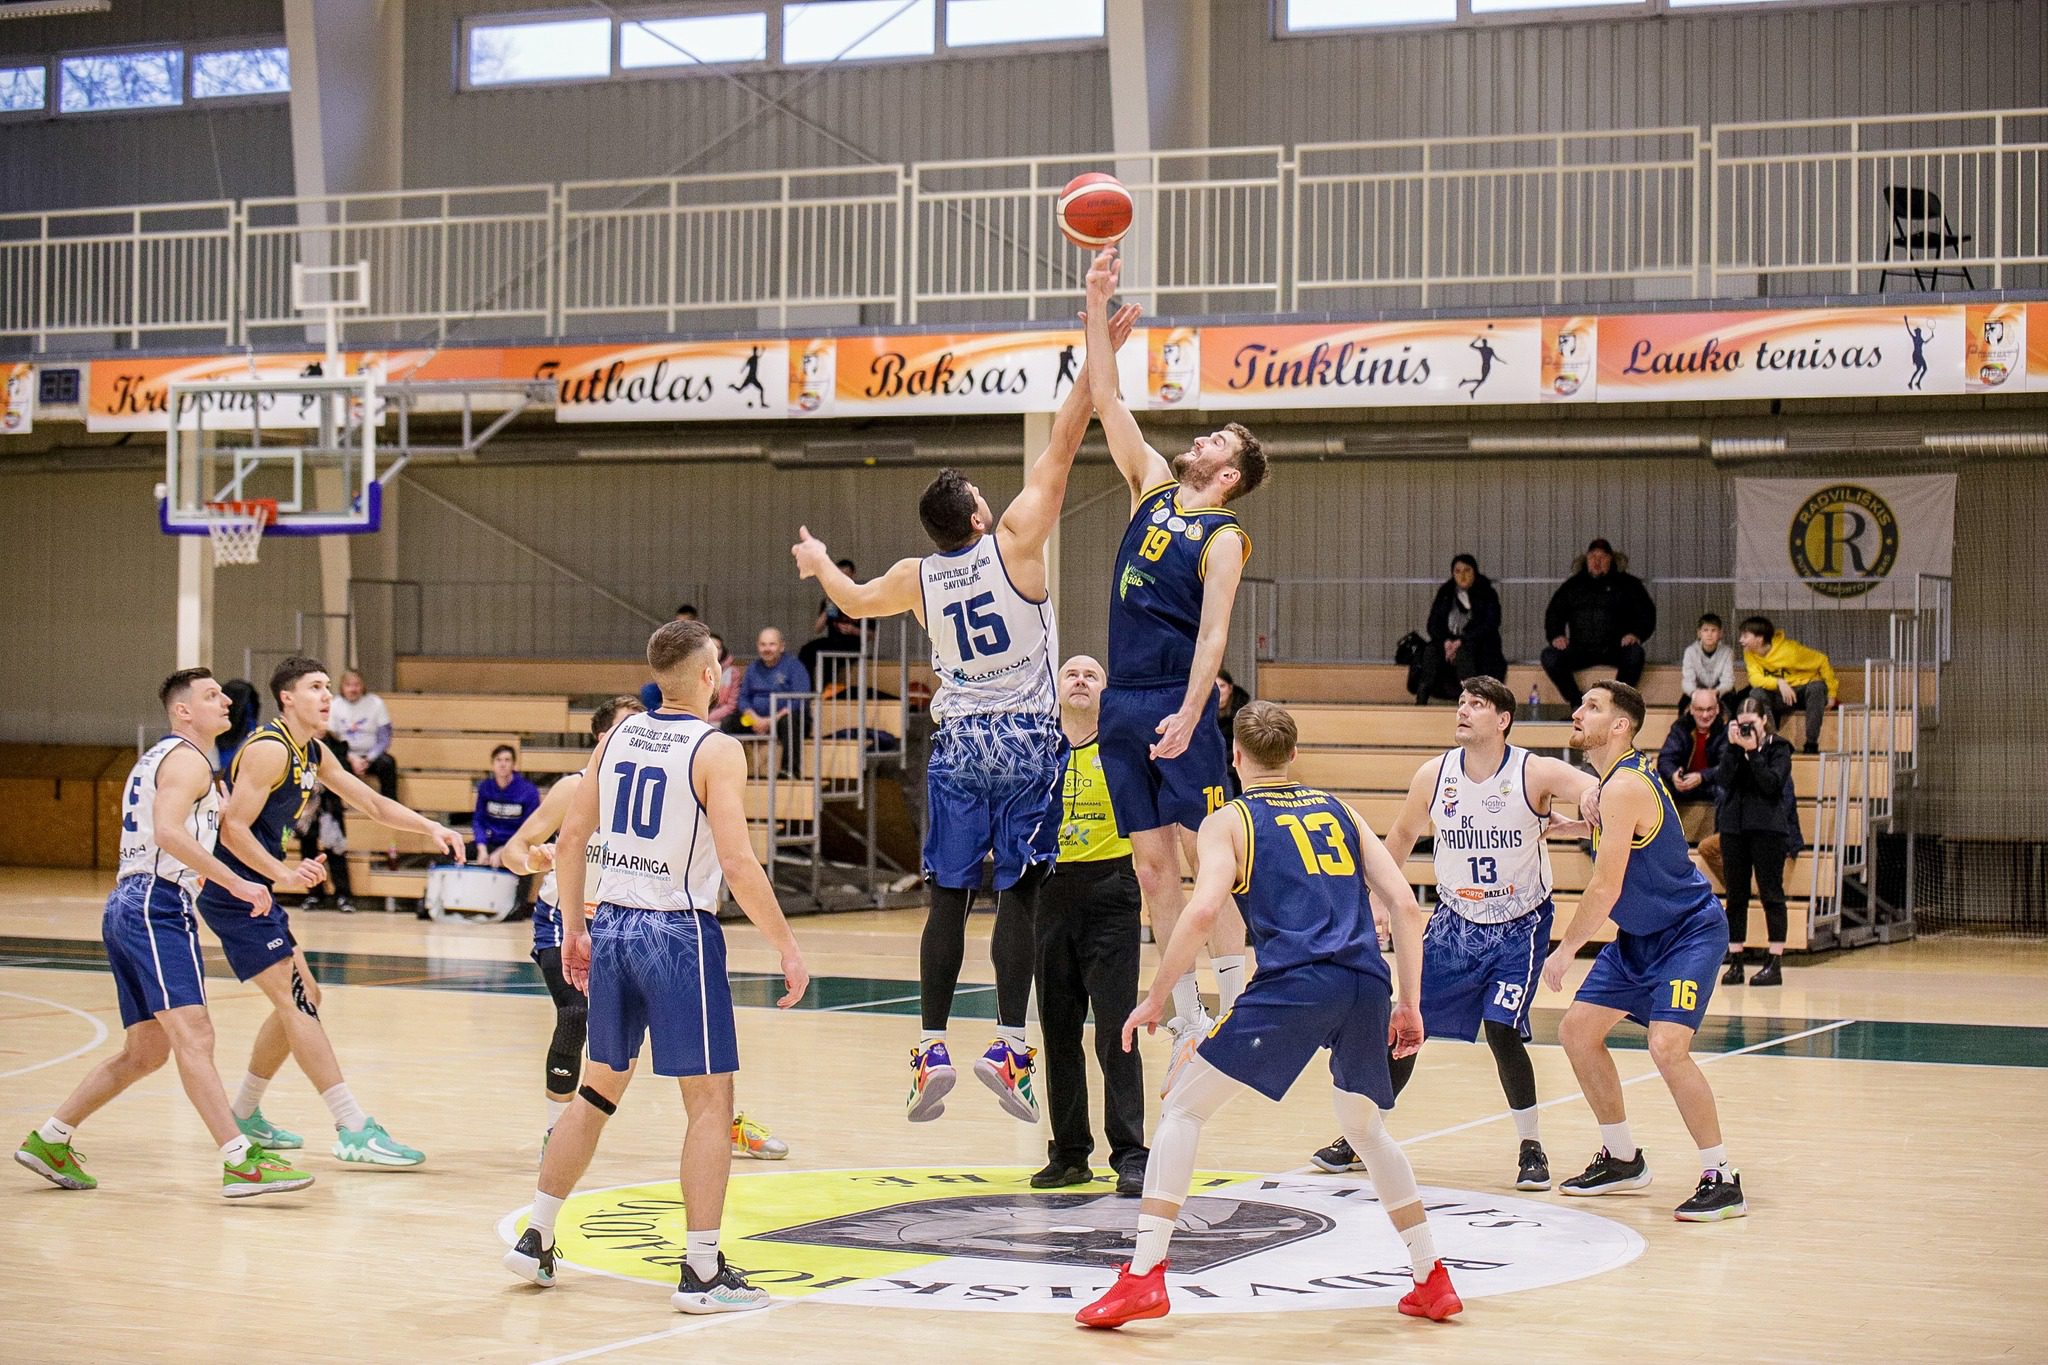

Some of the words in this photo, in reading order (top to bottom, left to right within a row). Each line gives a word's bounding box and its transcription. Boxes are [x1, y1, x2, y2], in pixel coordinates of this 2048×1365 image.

[865, 352, 1028, 398] Boksas
[1227, 342, 1430, 388] Tinklinis
[1623, 337, 1744, 375] Lauko
[1756, 338, 1882, 370] tenisas
[1800, 489, 1891, 527] RADVILIŠKIS
[1138, 525, 1172, 562] 19
[1818, 511, 1868, 573] R
[943, 591, 1011, 662] 15
[611, 761, 668, 839] 10
[1441, 826, 1522, 849] RADVILIŠKIS
[1461, 816, 1474, 829] BC
[1275, 812, 1356, 876] 13
[606, 852, 670, 875] HARINGA
[1467, 857, 1498, 884] 13
[1493, 981, 1523, 1011] 13
[1669, 979, 1698, 1011] 16
